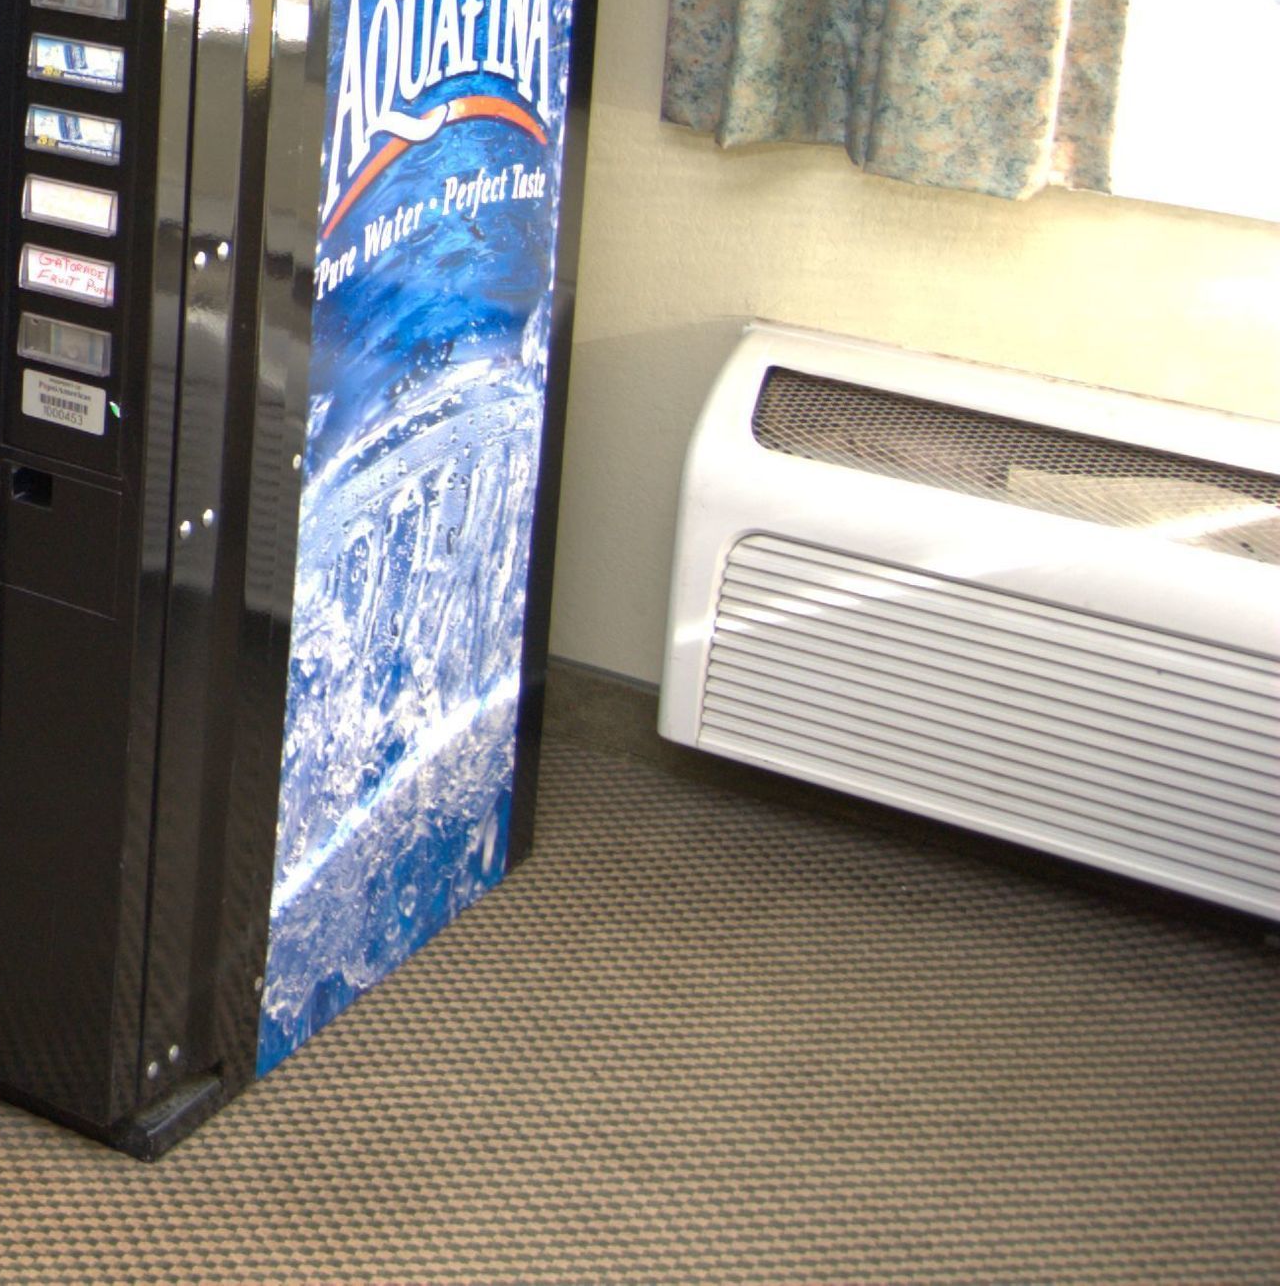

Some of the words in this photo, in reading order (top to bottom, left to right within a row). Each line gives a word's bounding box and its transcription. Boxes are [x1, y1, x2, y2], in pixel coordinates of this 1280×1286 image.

[38, 252, 105, 280] GATORADE
[315, 243, 356, 301] Pure
[364, 198, 425, 264] Water
[442, 168, 508, 219] Perfect
[512, 164, 547, 200] Taste
